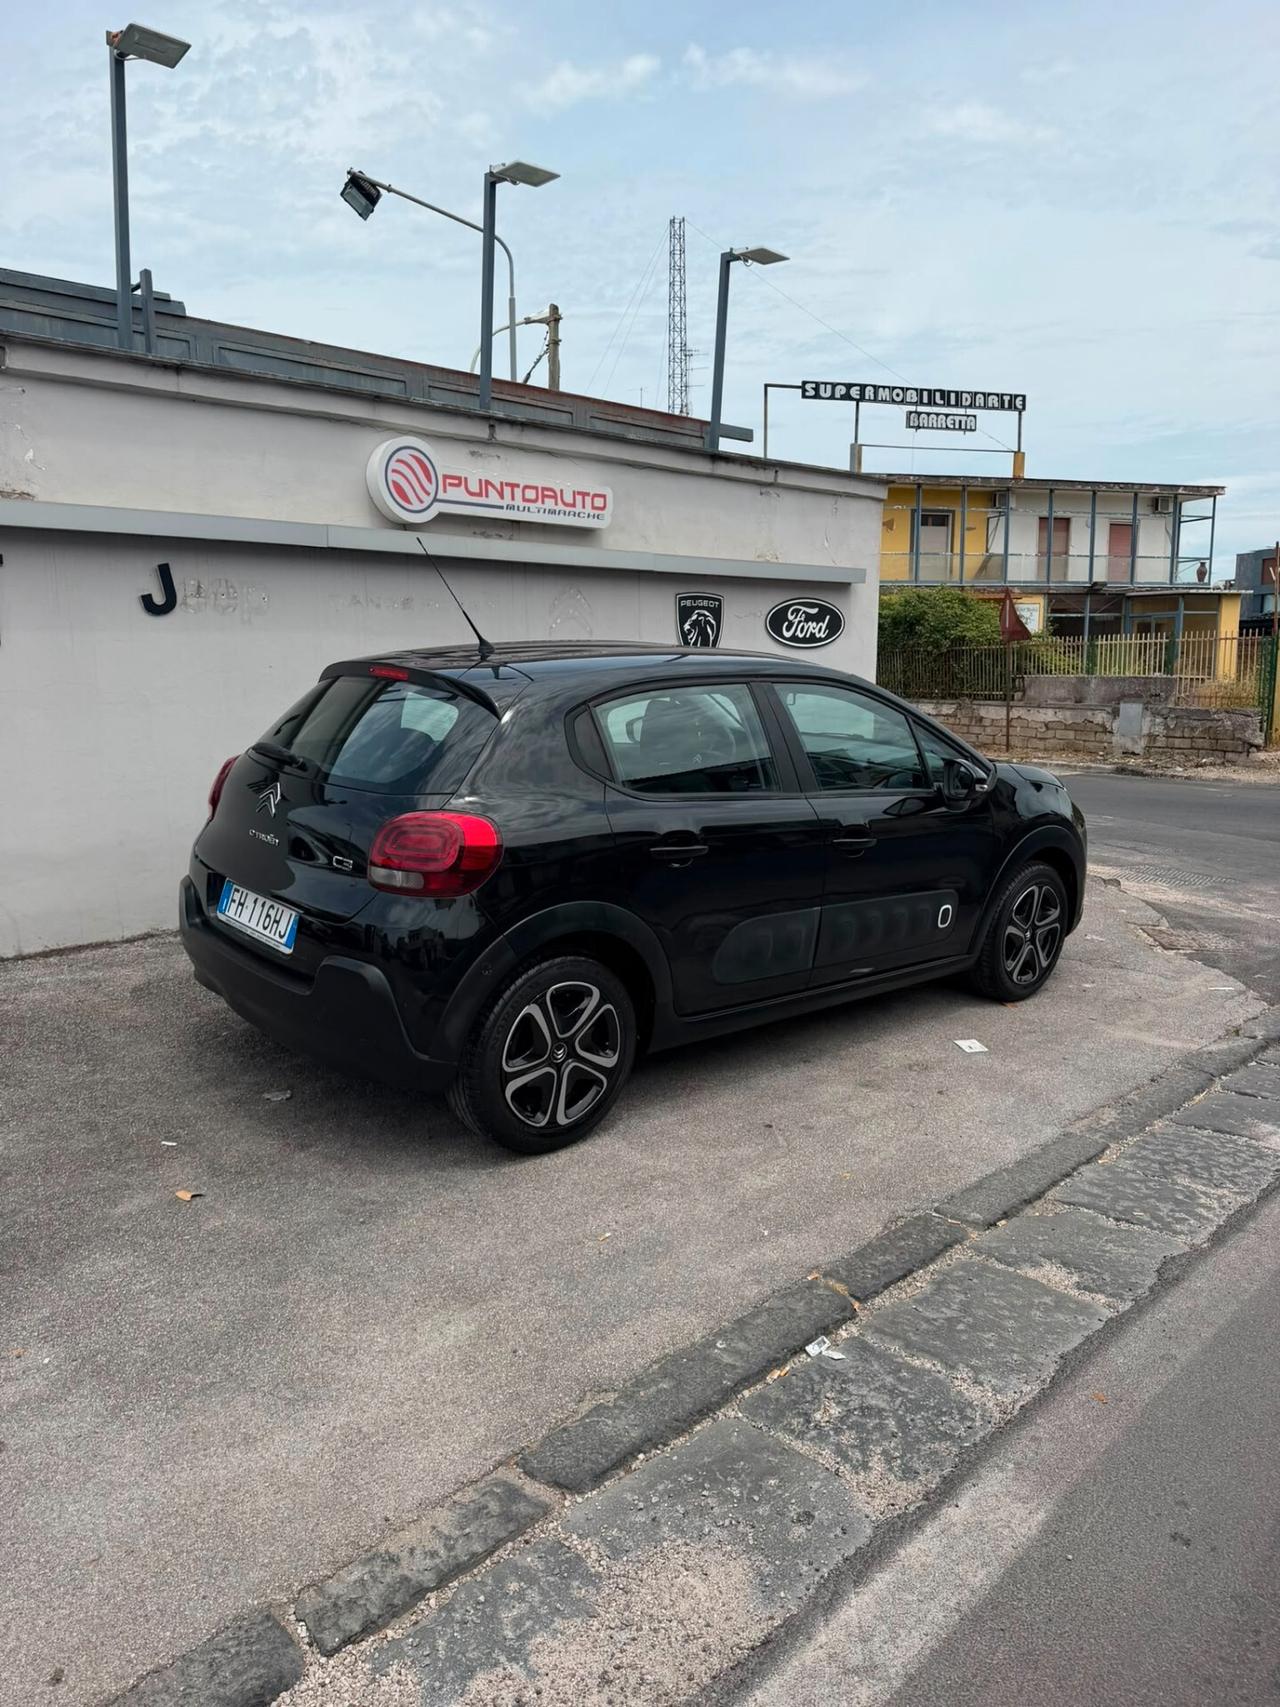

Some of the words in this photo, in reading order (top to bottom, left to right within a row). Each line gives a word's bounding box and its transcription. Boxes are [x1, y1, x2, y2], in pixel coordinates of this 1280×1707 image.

[909, 413, 976, 430] BARRETTA
[442, 473, 607, 512] PUNTOAUTO
[505, 503, 606, 521] MULTIMARCHE
[680, 599, 720, 609] PEUGEOT
[782, 605, 831, 639] Ford
[332, 855, 353, 871] C3
